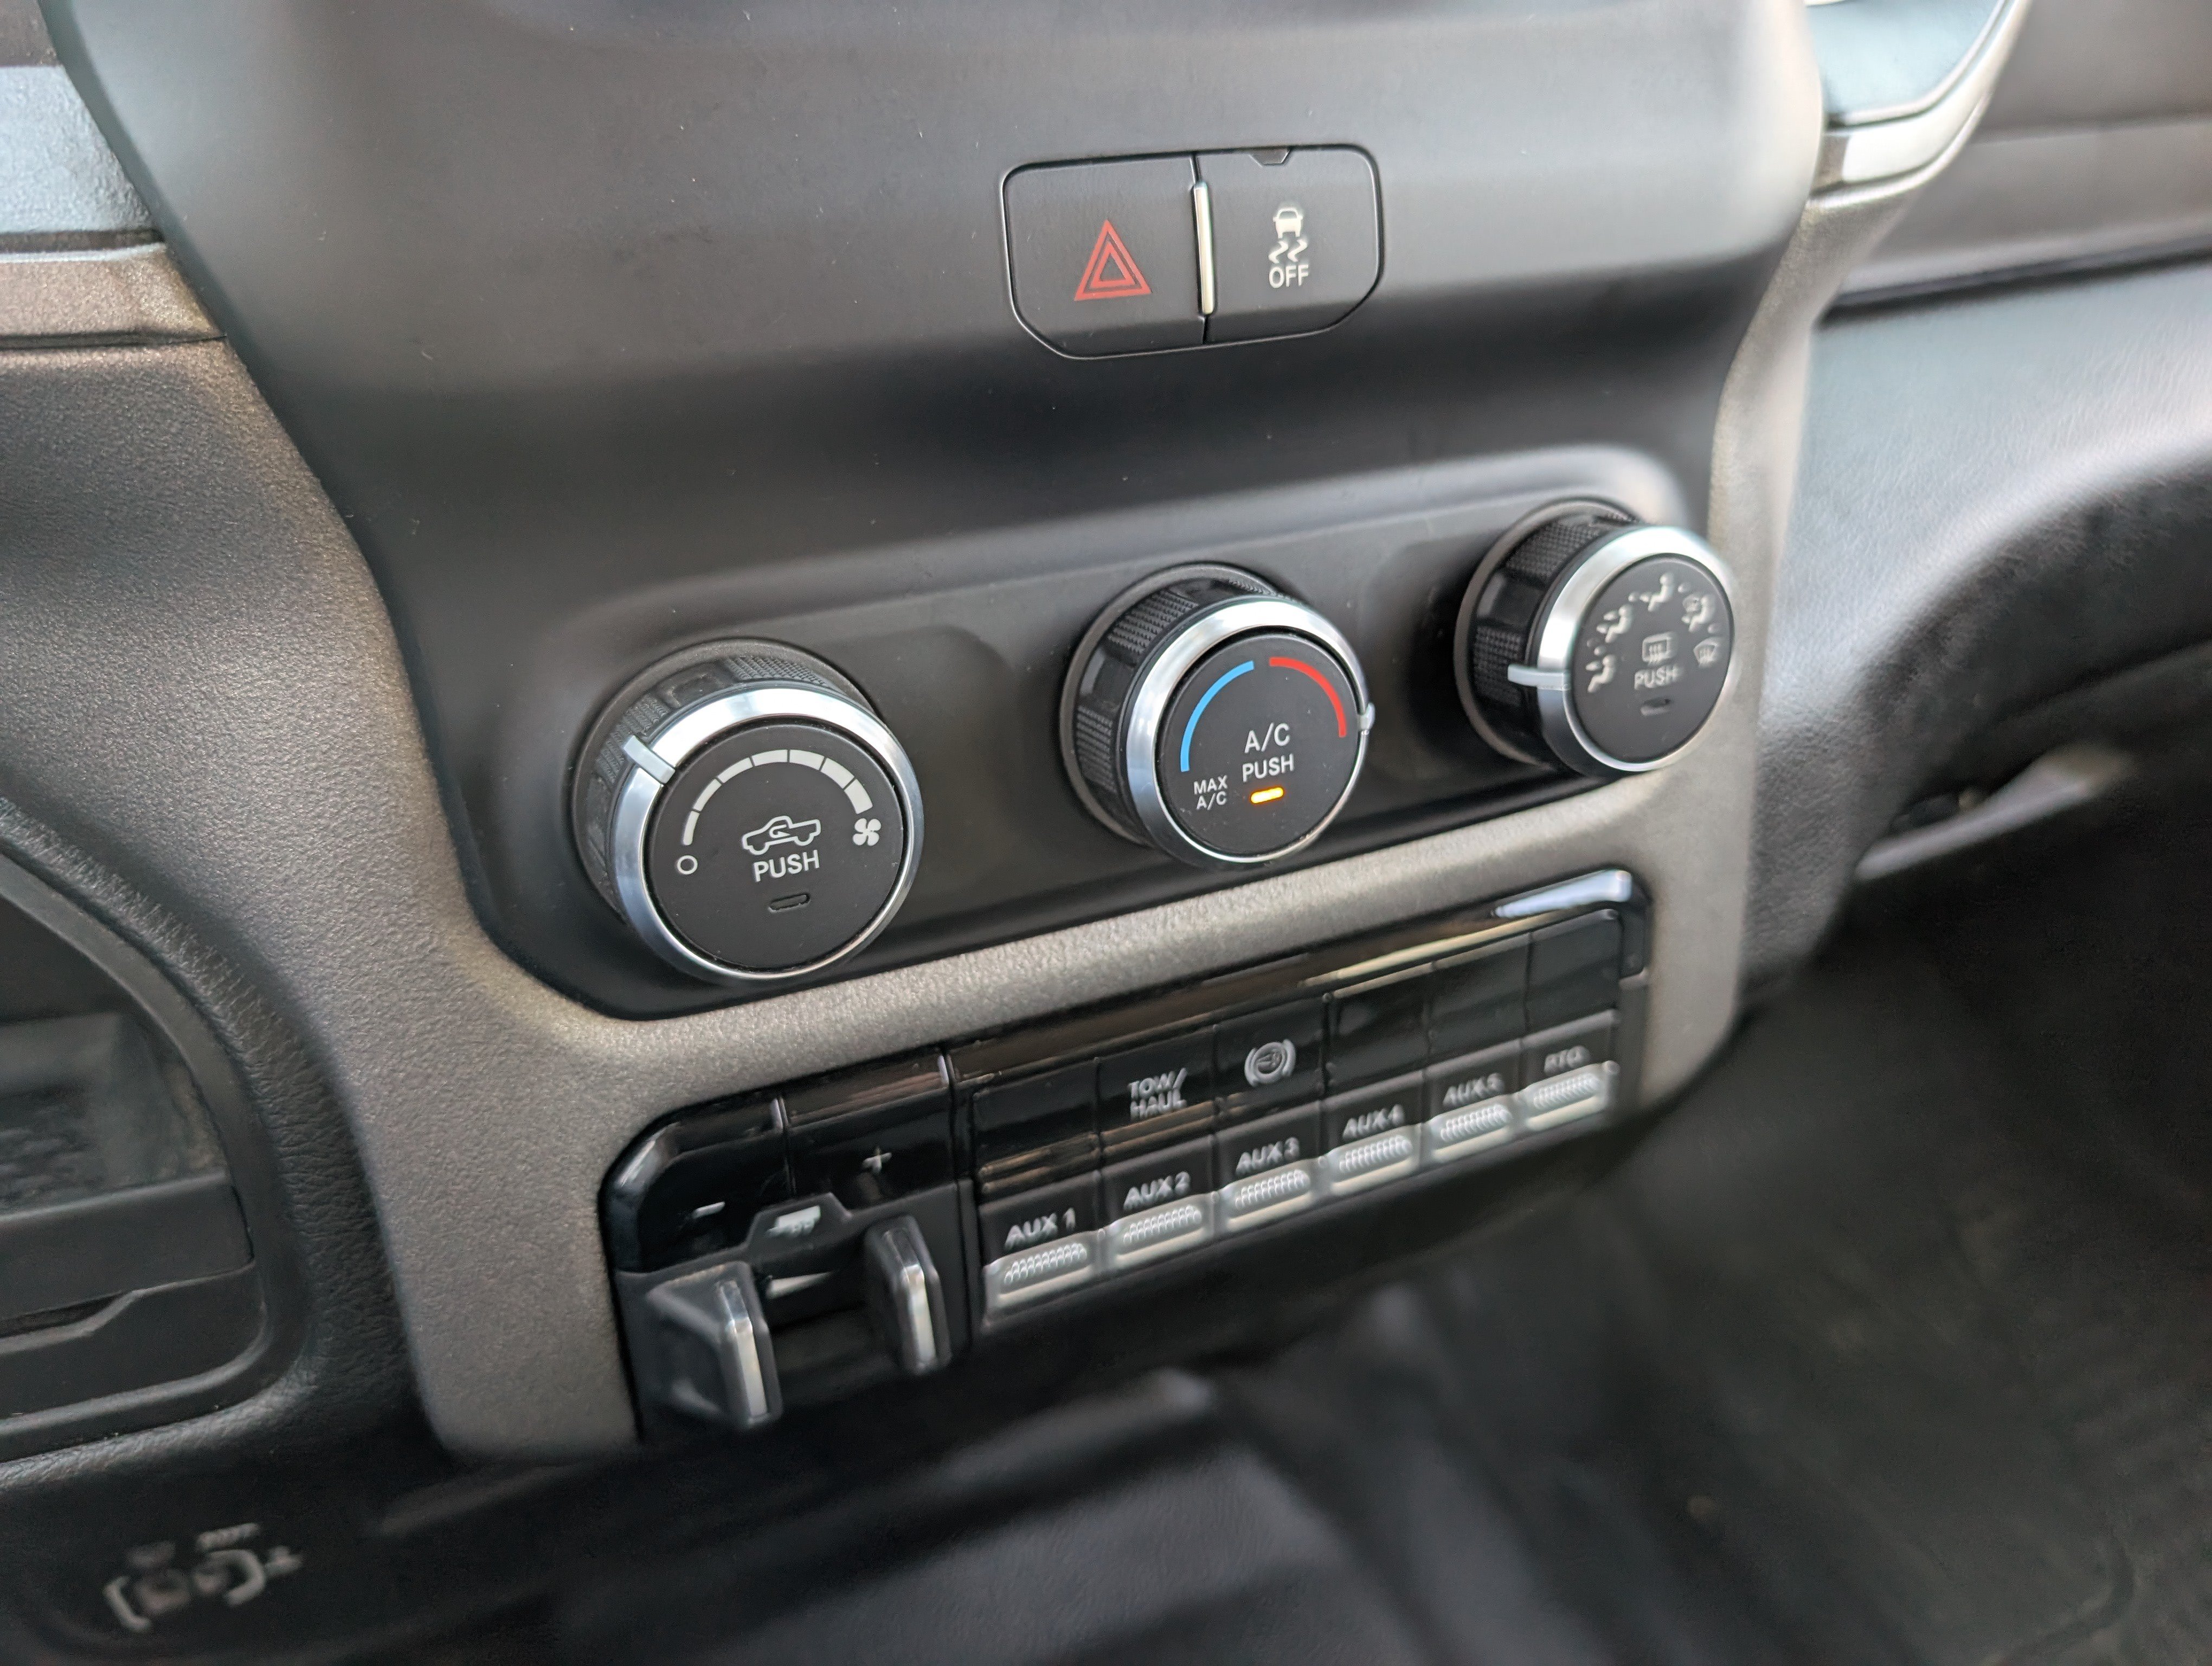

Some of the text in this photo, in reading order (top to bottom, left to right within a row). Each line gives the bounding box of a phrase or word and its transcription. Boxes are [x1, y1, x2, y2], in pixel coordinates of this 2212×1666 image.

[1269, 265, 1309, 289] OFF
[1634, 664, 1682, 690] PUSH
[1244, 722, 1290, 753] A/C
[1242, 753, 1295, 782] PUSH
[1194, 775, 1228, 795] MAX
[1196, 791, 1227, 810] A/C
[754, 849, 820, 882] PUSH
[1005, 1213, 1058, 1250] AUX
